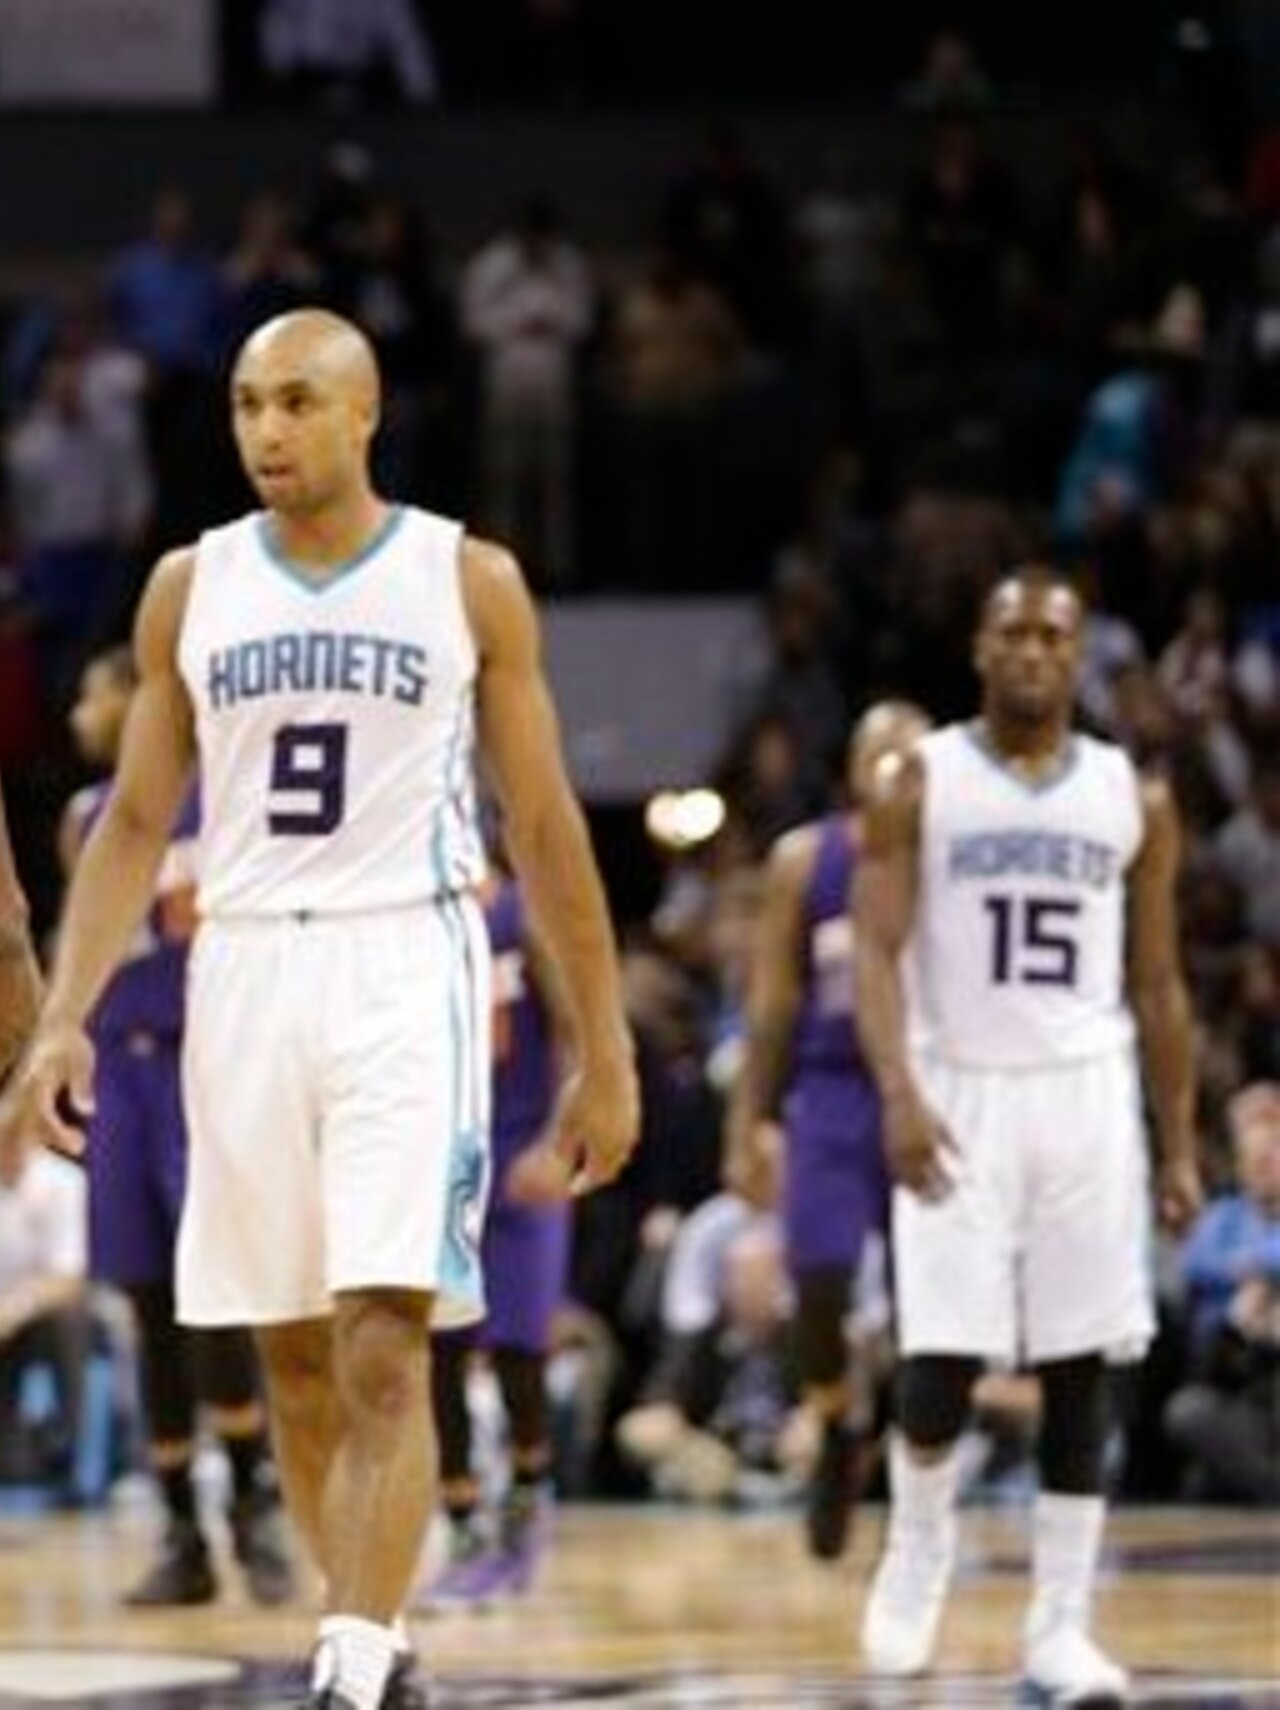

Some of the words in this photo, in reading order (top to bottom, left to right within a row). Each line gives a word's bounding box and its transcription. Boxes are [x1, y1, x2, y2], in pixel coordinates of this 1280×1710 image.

[208, 631, 427, 709] HORNETS
[267, 724, 347, 834] 9
[984, 894, 1081, 986] 15
